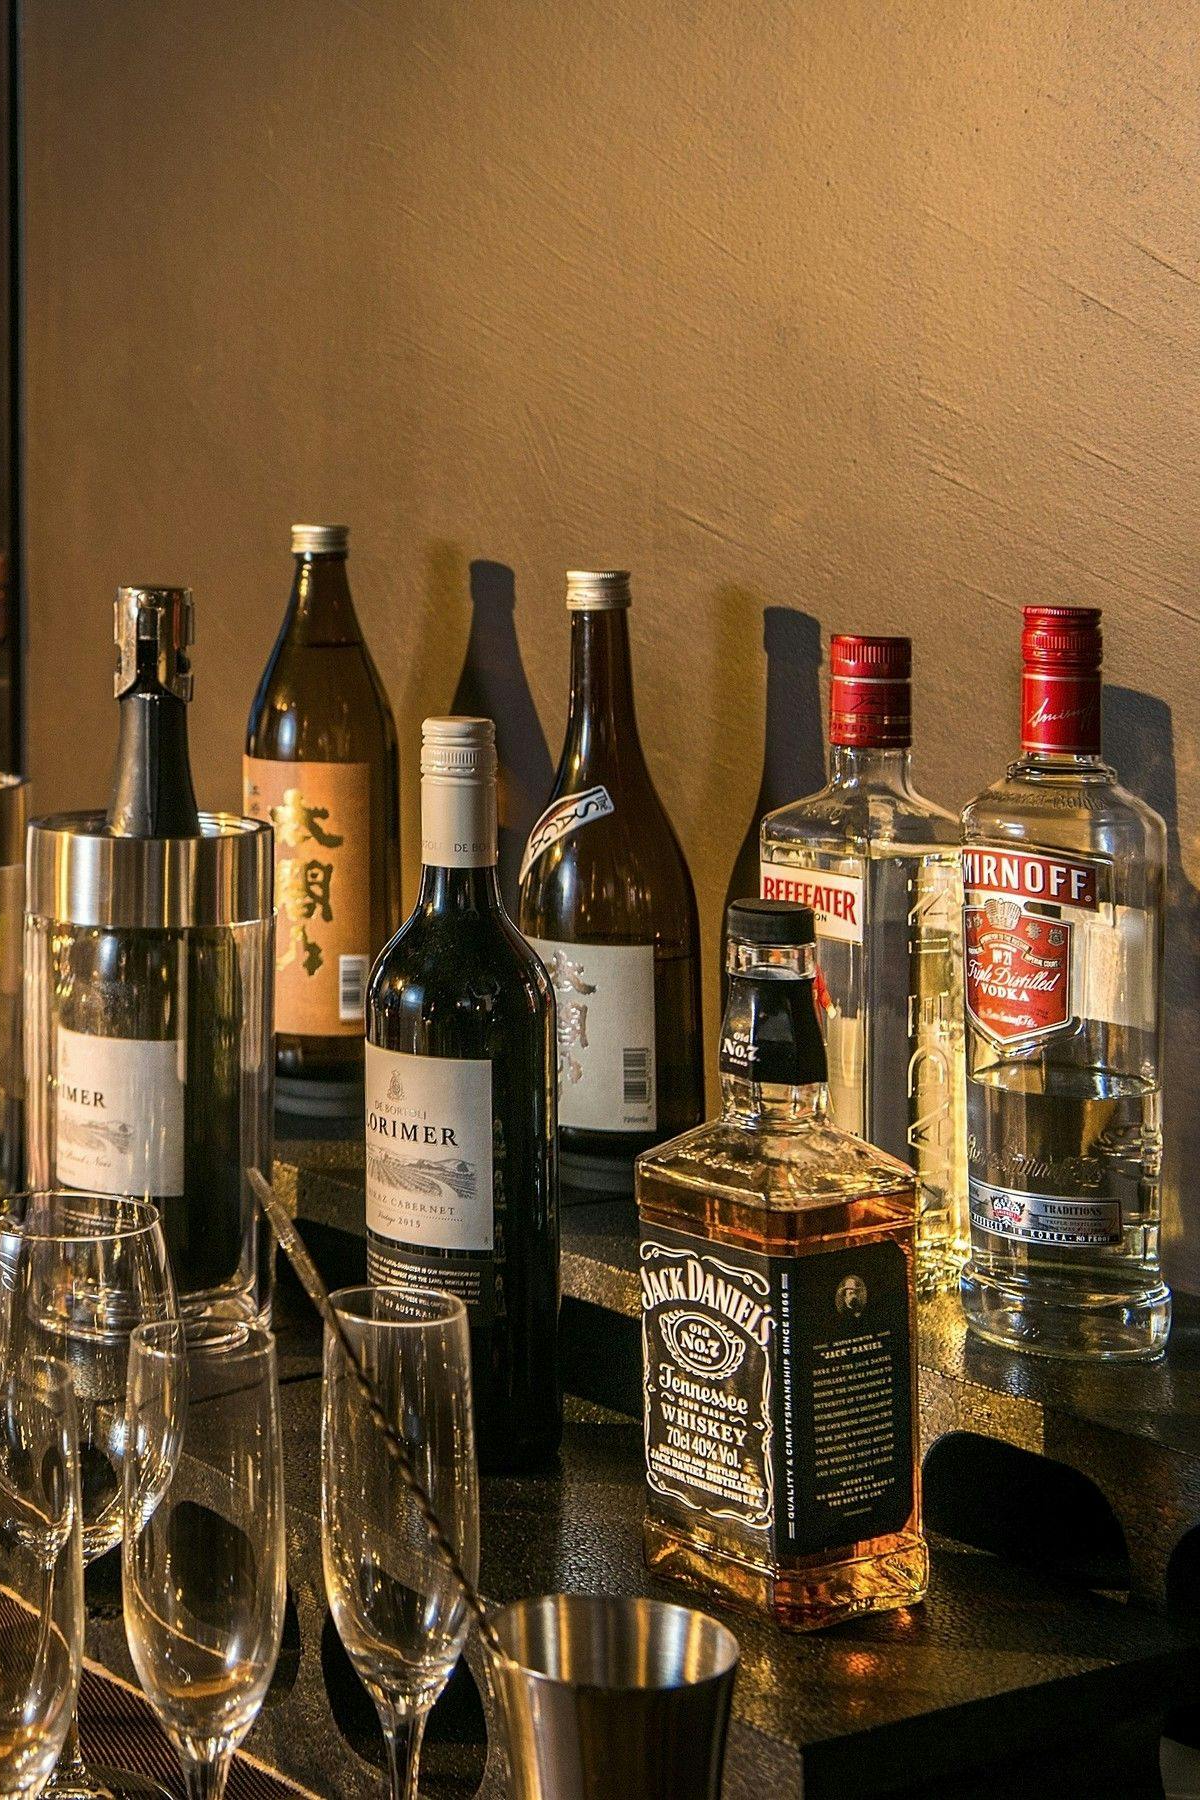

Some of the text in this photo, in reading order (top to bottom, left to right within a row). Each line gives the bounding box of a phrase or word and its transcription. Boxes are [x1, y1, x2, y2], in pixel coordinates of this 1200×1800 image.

[962, 853, 1087, 900] MIRNOFF
[763, 876, 857, 926] BEEFEATER
[968, 959, 1061, 992] Triple Distilled
[981, 982, 1030, 1002] VODKA
[61, 1083, 106, 1109] IMER
[390, 1197, 456, 1216] CABERNET
[640, 1259, 778, 1346] JACK DANIEL'S
[782, 1321, 791, 1355] SINCE
[659, 1362, 749, 1415] Tennessee
[783, 1358, 793, 1456] CRAFTSMANSHIP
[660, 1402, 748, 1447] WHISKEY
[785, 1469, 795, 1519] QUALITY
